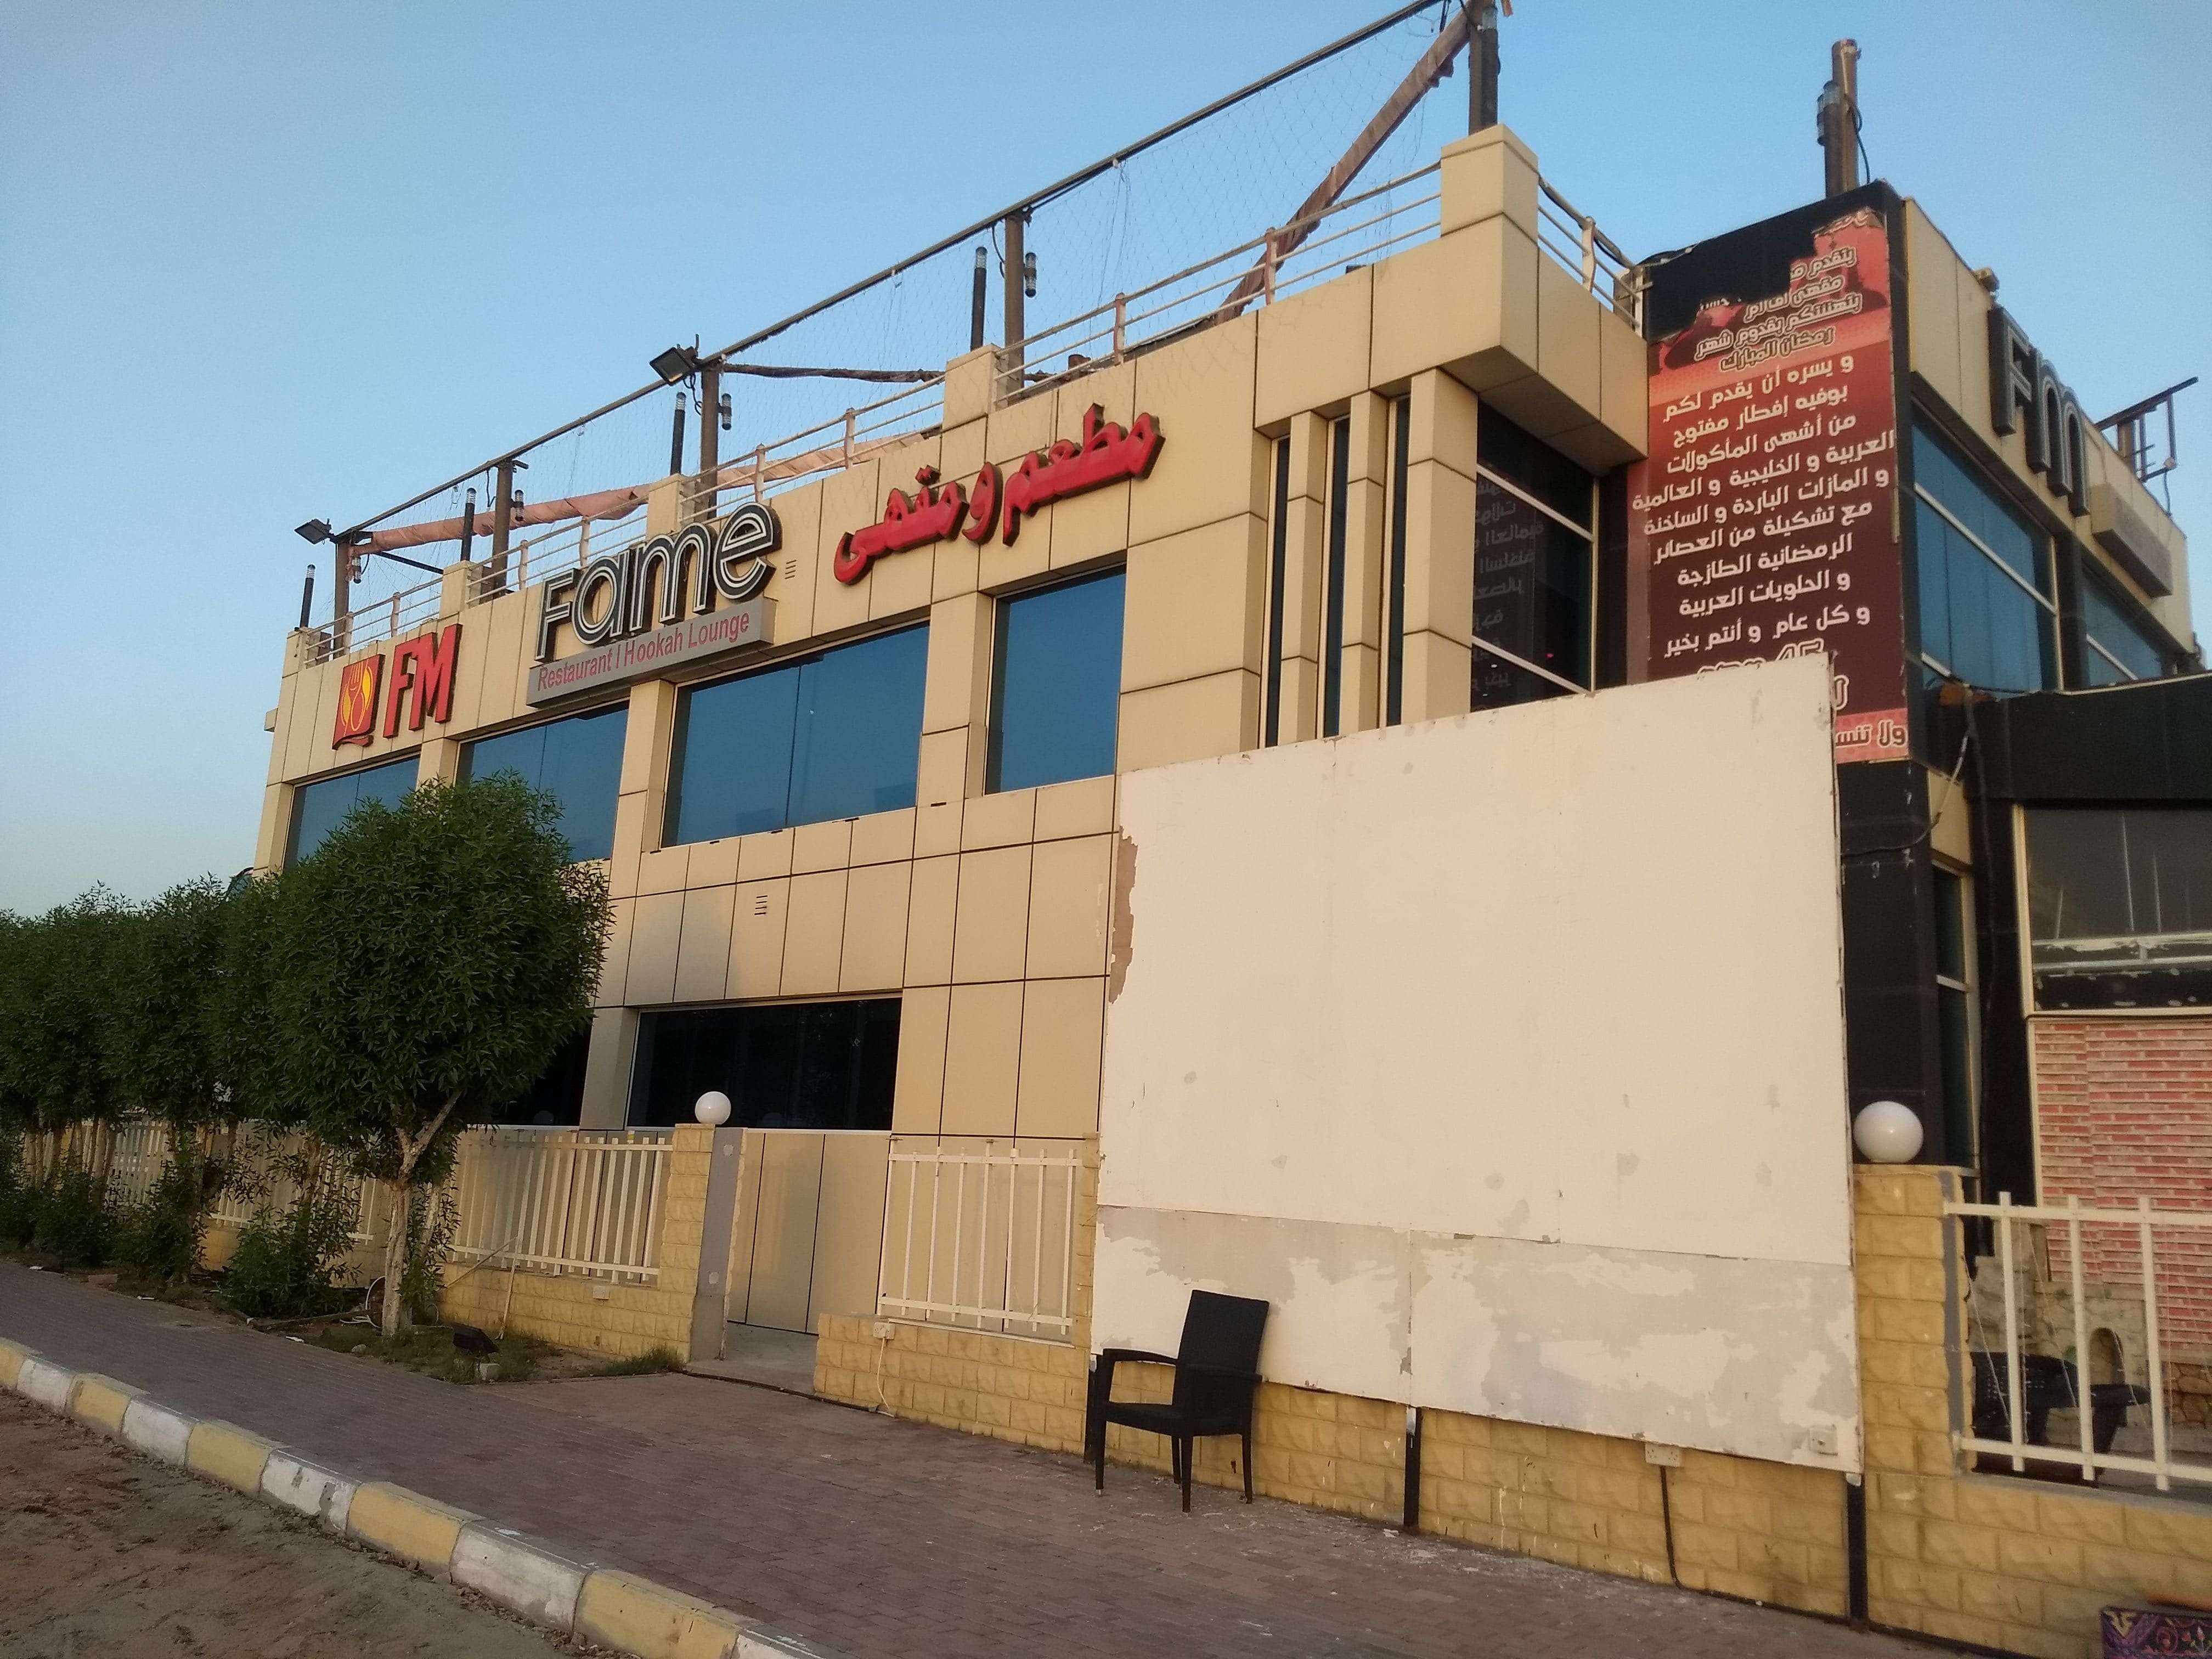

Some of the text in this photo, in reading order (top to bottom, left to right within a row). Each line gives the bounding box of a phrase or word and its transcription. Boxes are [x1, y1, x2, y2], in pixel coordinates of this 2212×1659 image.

[1694, 329, 1734, 362] شهر
[1720, 326, 1836, 372] رمضان المبارك
[1734, 317, 1785, 348] بقدوم
[1787, 360, 1832, 384] يسره
[1663, 391, 1701, 422] لكم
[1708, 381, 1752, 410] يقدم
[1673, 385, 1848, 448] بوفيه إفطار مفتوح
[1667, 413, 1857, 473] من أشهى المأكولات
[1825, 430, 1895, 465] العربية
[1003, 403, 1166, 547] مطعم
[1729, 453, 1800, 488] الخليجية
[1797, 467, 1868, 500] المازات
[1632, 477, 1702, 511] العالمية
[1733, 485, 1789, 515] الباردة
[1644, 504, 1709, 535] الساخنة
[1762, 505, 1836, 537] تشكيلة
[1841, 501, 1873, 527] مع
[1729, 527, 1756, 548] من
[1677, 532, 1853, 588] الرمضانية الطازجة
[535, 502, 781, 661] Fame
[1750, 569, 1830, 602] الحلويات
[1679, 585, 1744, 617] العربية
[1816, 604, 1850, 631] كل
[1705, 617, 1742, 652] أنتم
[1772, 612, 1809, 640] عام
[538, 649, 612, 691] Restaurant
[624, 627, 684, 667] Hookah
[688, 611, 749, 648] Lounge
[1664, 633, 1700, 658] بخير
[383, 624, 462, 738] FM
[1835, 724, 1872, 748] تنس
